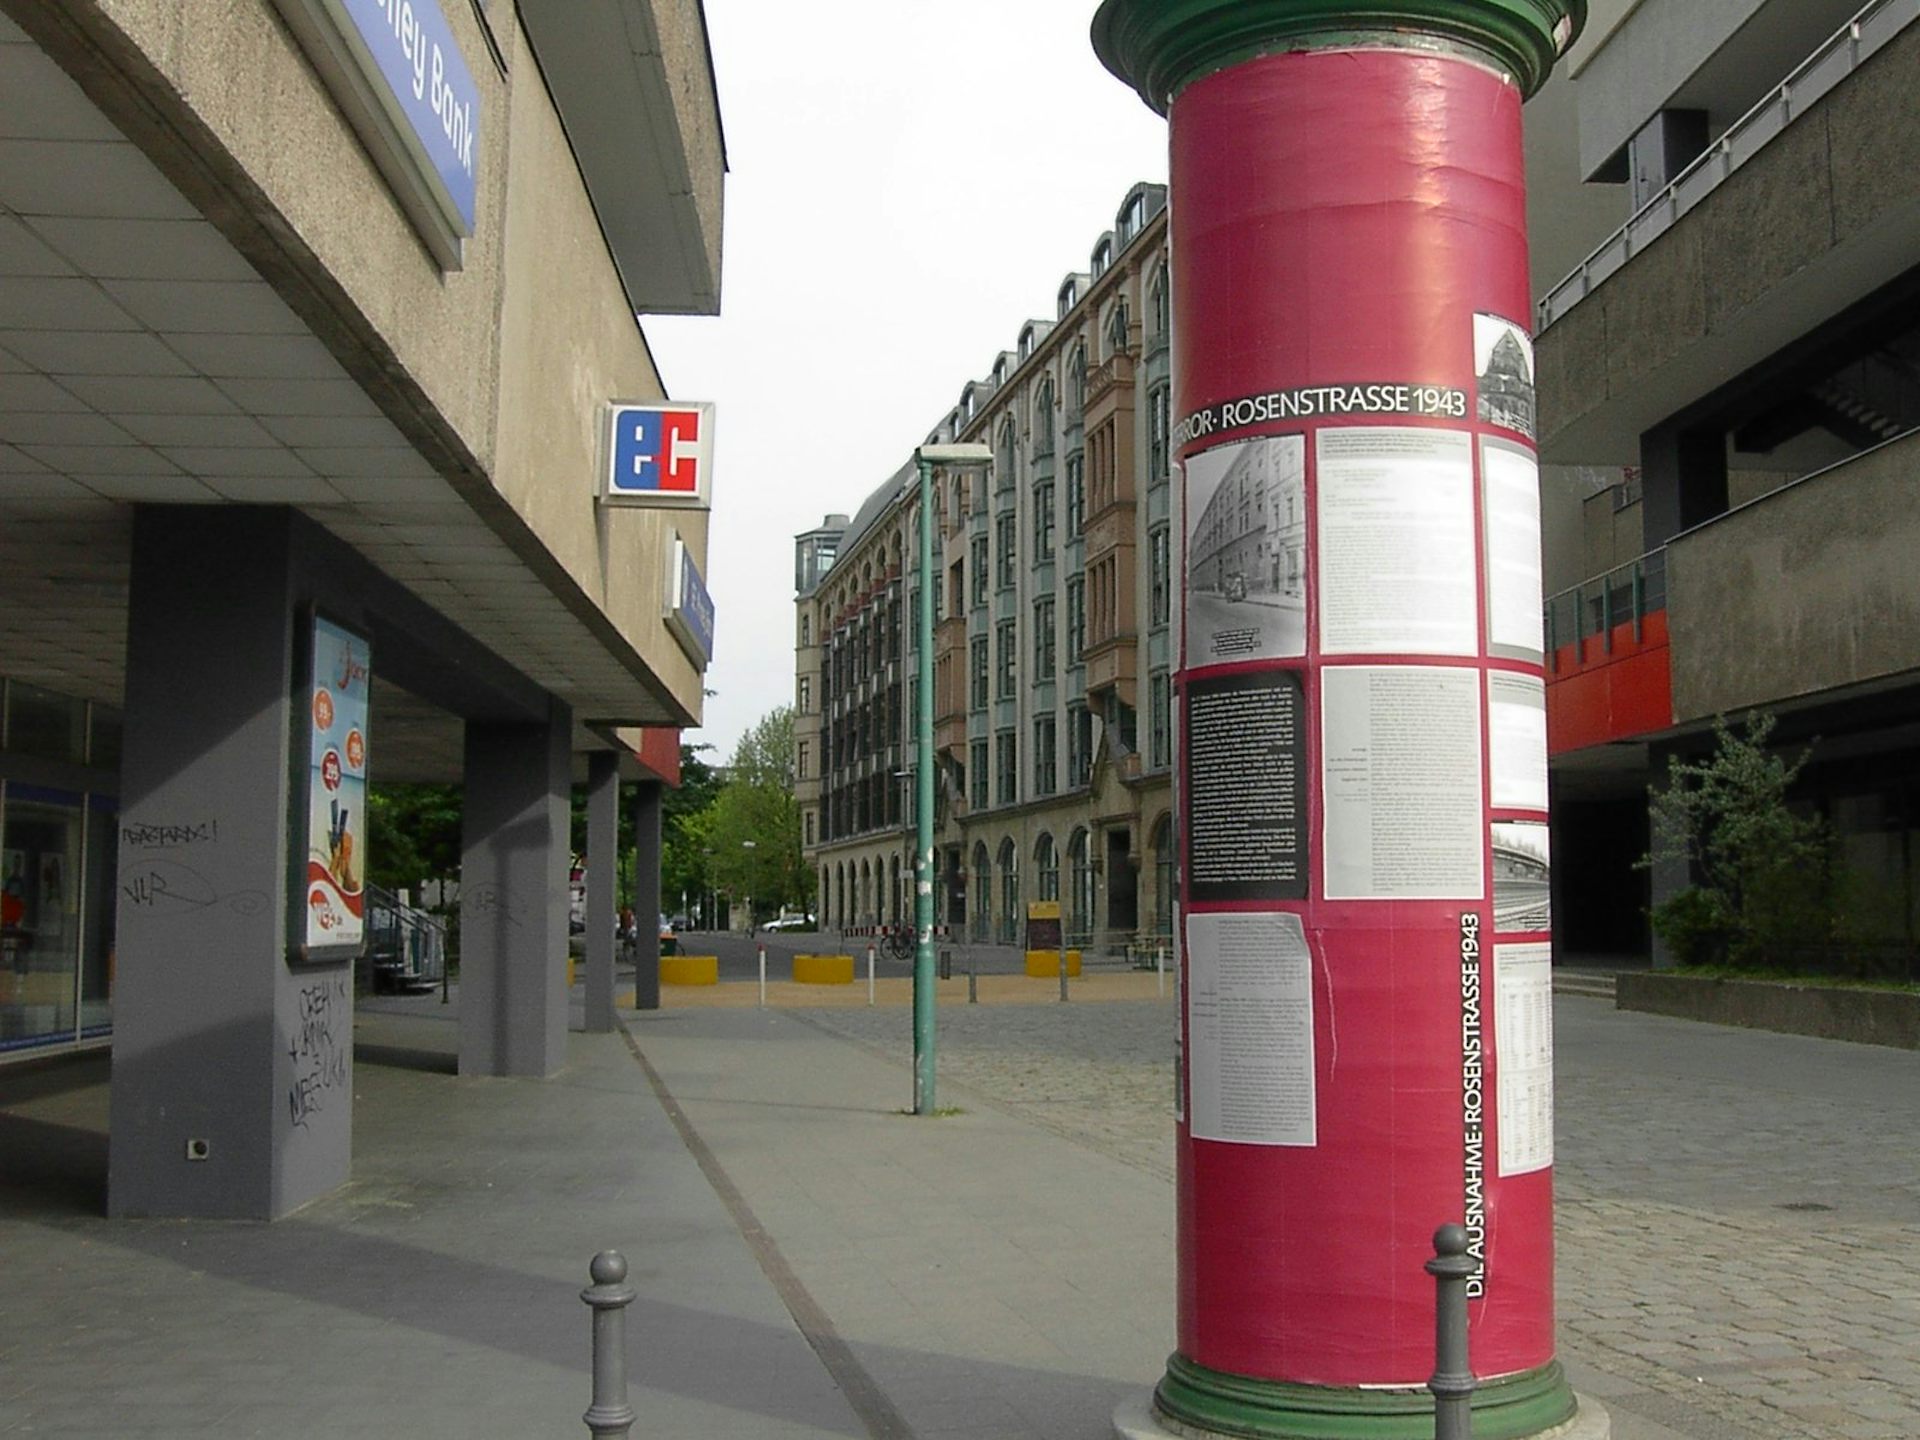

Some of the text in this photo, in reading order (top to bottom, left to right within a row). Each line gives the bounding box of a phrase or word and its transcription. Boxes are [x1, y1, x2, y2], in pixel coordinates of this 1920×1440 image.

[431, 43, 473, 178] Bank
[1222, 385, 1409, 429] ROSENSTRASSE
[1413, 387, 1466, 417] 1943
[1460, 913, 1480, 960] 1943
[1461, 962, 1483, 1123] ROSENSTRASSE
[1464, 1132, 1485, 1259] AUSNAHME
